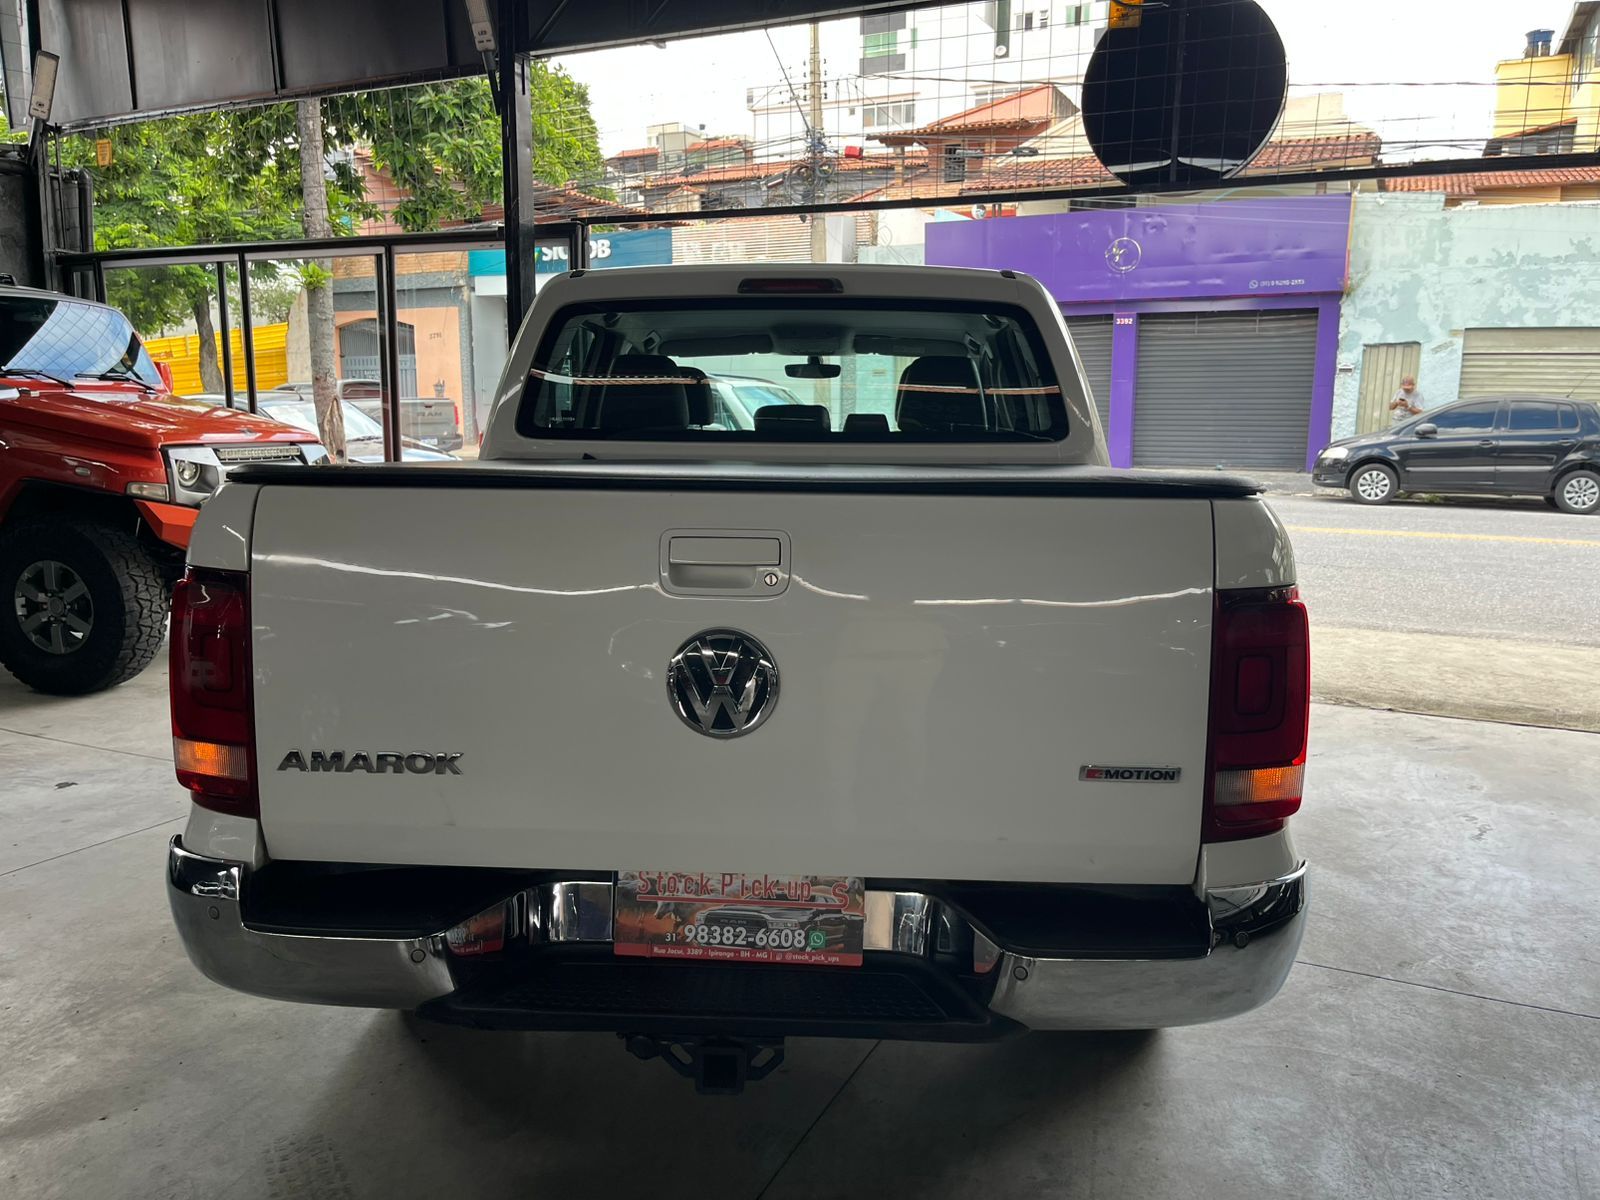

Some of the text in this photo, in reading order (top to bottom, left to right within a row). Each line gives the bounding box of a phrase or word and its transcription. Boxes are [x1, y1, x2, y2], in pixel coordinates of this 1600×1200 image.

[276, 749, 464, 775] AMAROK
[637, 870, 713, 897] Stock
[665, 924, 807, 948] 31 98382-6608
